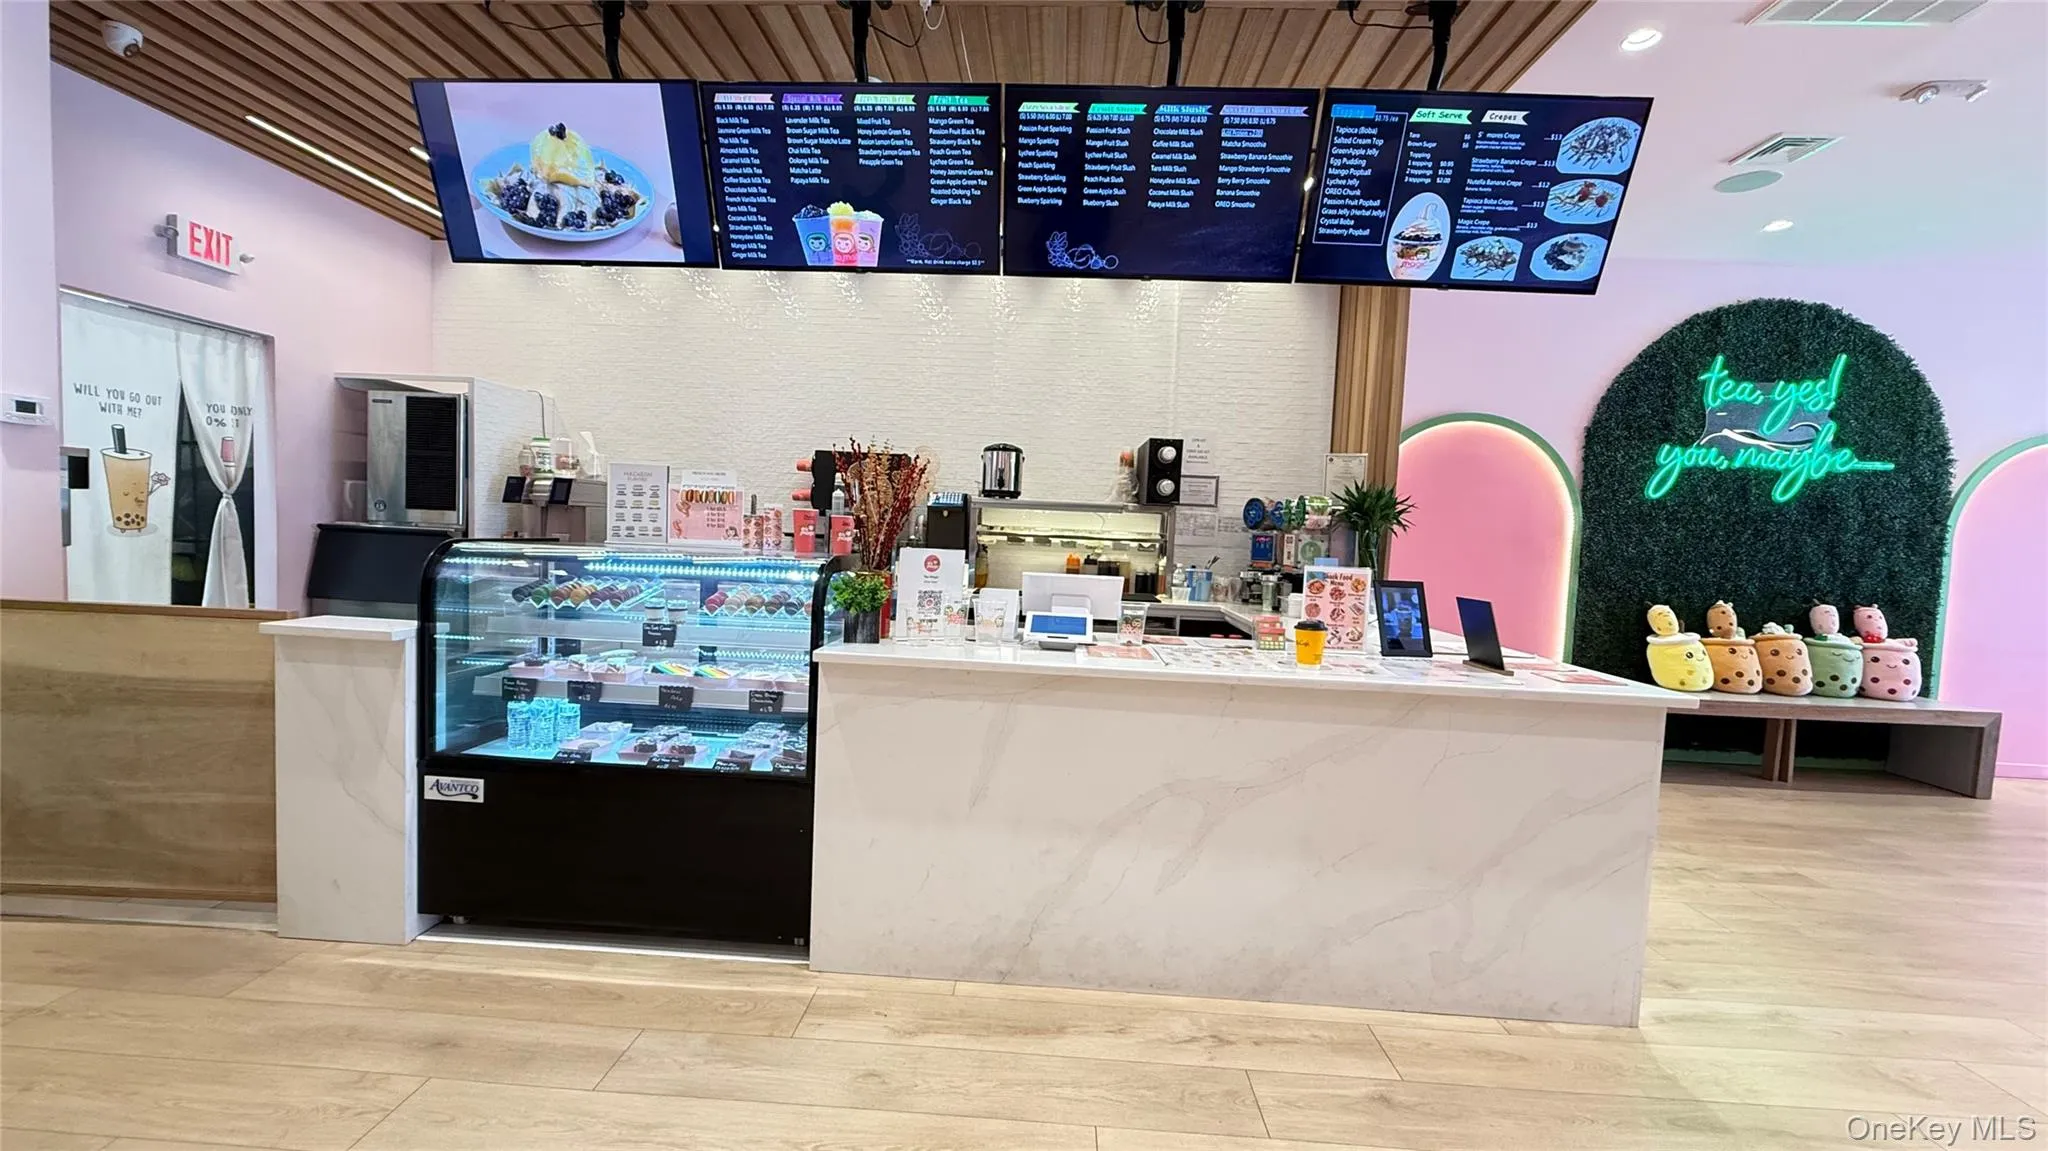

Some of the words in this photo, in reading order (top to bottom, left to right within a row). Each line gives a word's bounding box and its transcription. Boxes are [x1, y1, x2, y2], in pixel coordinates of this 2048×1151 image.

[1159, 105, 1179, 114] Milk
[1180, 106, 1206, 114] Slush
[1417, 111, 1435, 119] Soft
[1437, 111, 1464, 120] Serve
[1489, 112, 1517, 122] Crepes
[1336, 125, 1357, 134] Tapioca
[1358, 127, 1378, 135] (Boba)
[1334, 136, 1351, 145] Salted
[1352, 137, 1371, 145] Cream
[1372, 138, 1384, 146] Top
[1503, 132, 1520, 140] Crepe
[1332, 147, 1365, 156] GreenApple
[1366, 148, 1379, 156] Jelly
[1330, 157, 1341, 165] Egg
[1342, 157, 1366, 166] Pudding
[1520, 159, 1536, 167] Crepe
[1328, 167, 1348, 176] Mango
[1349, 168, 1371, 177] Popball
[1327, 177, 1346, 186] Lychee
[1347, 178, 1359, 186] Jelly
[1506, 179, 1522, 187] Crepe
[1325, 187, 1341, 196] OREO
[1342, 188, 1361, 196] Chunk
[1324, 197, 1344, 205] Passion
[1345, 198, 1357, 206] Fruit
[1358, 198, 1380, 207] Popball
[1498, 198, 1513, 206] Crepe
[1322, 207, 1337, 215] Grass
[1338, 208, 1349, 216] Jelly
[1350, 208, 1371, 217] (Herbal
[1372, 209, 1385, 217] Jelly)
[1320, 217, 1338, 226] Crystal
[1339, 218, 1354, 226] Boba
[1458, 218, 1473, 226] Magic
[1474, 218, 1489, 226] Crepe
[1319, 227, 1347, 235] Strawberry
[1348, 228, 1370, 236] Popball
[189, 221, 233, 266] EXIT
[73, 382, 100, 397] WILL
[106, 389, 125, 401] YOU
[130, 392, 141, 404] GO
[146, 394, 162, 407] OUT
[1697, 353, 1764, 409] tea,
[1758, 353, 1848, 435] yes!
[98, 402, 122, 415] WITH
[127, 406, 142, 420] ME?
[206, 403, 226, 414] YOU
[231, 405, 253, 417] ONLY
[206, 416, 227, 428] 0%
[1644, 443, 1728, 500] you,
[1733, 422, 1894, 502] maybe
[429, 779, 479, 796] AVANTCO
